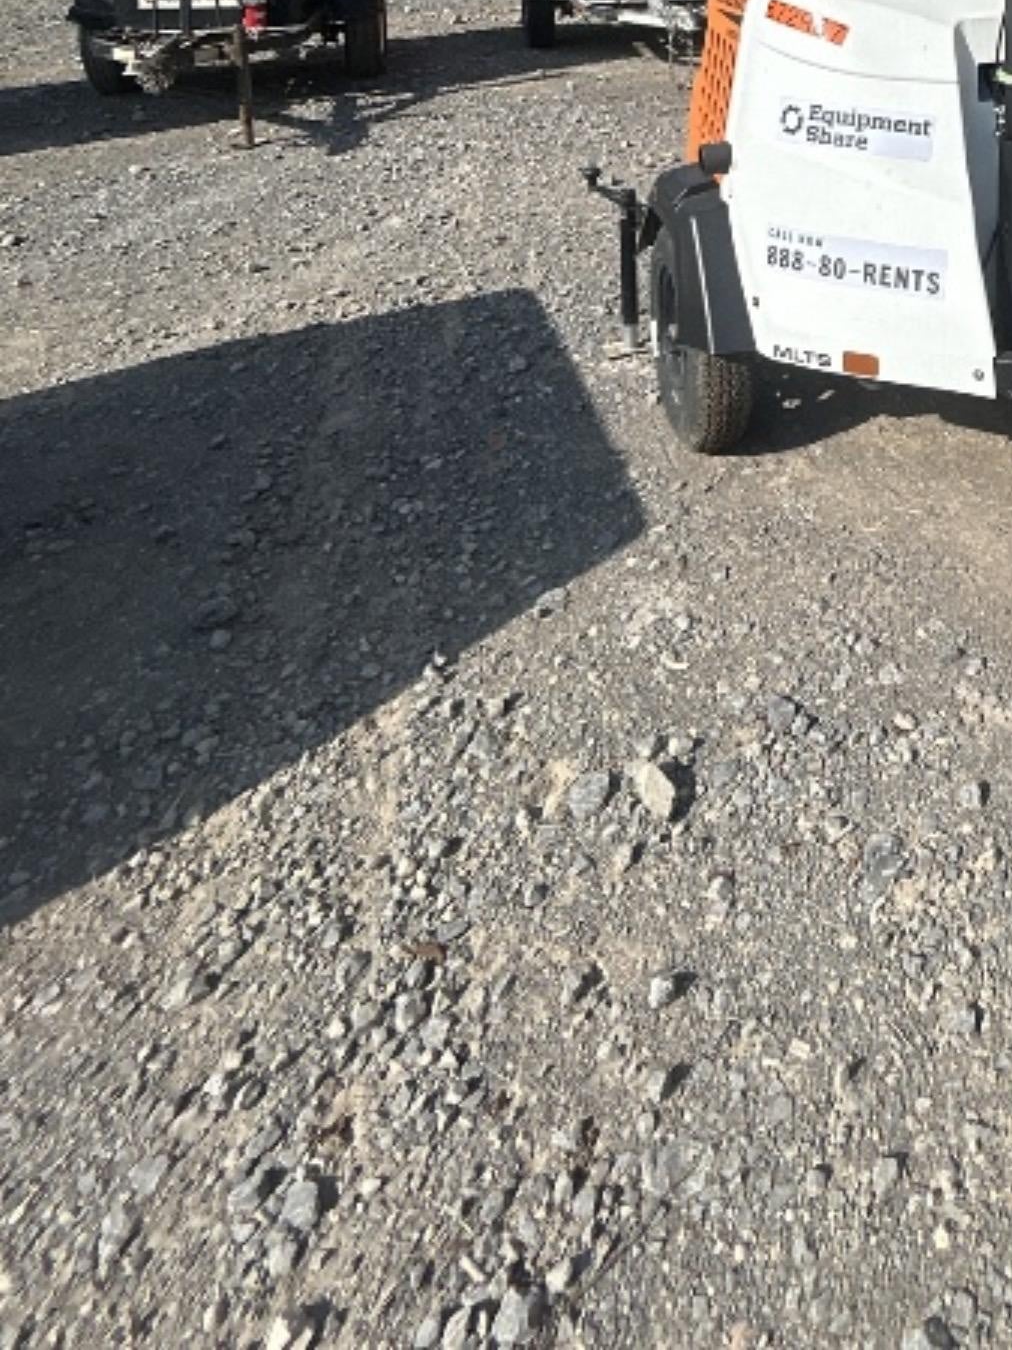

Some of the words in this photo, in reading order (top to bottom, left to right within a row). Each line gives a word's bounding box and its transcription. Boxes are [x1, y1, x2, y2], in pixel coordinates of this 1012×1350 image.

[808, 104, 932, 136] Equipment
[806, 125, 868, 150] Share
[766, 244, 941, 295] 888-80-RENTS
